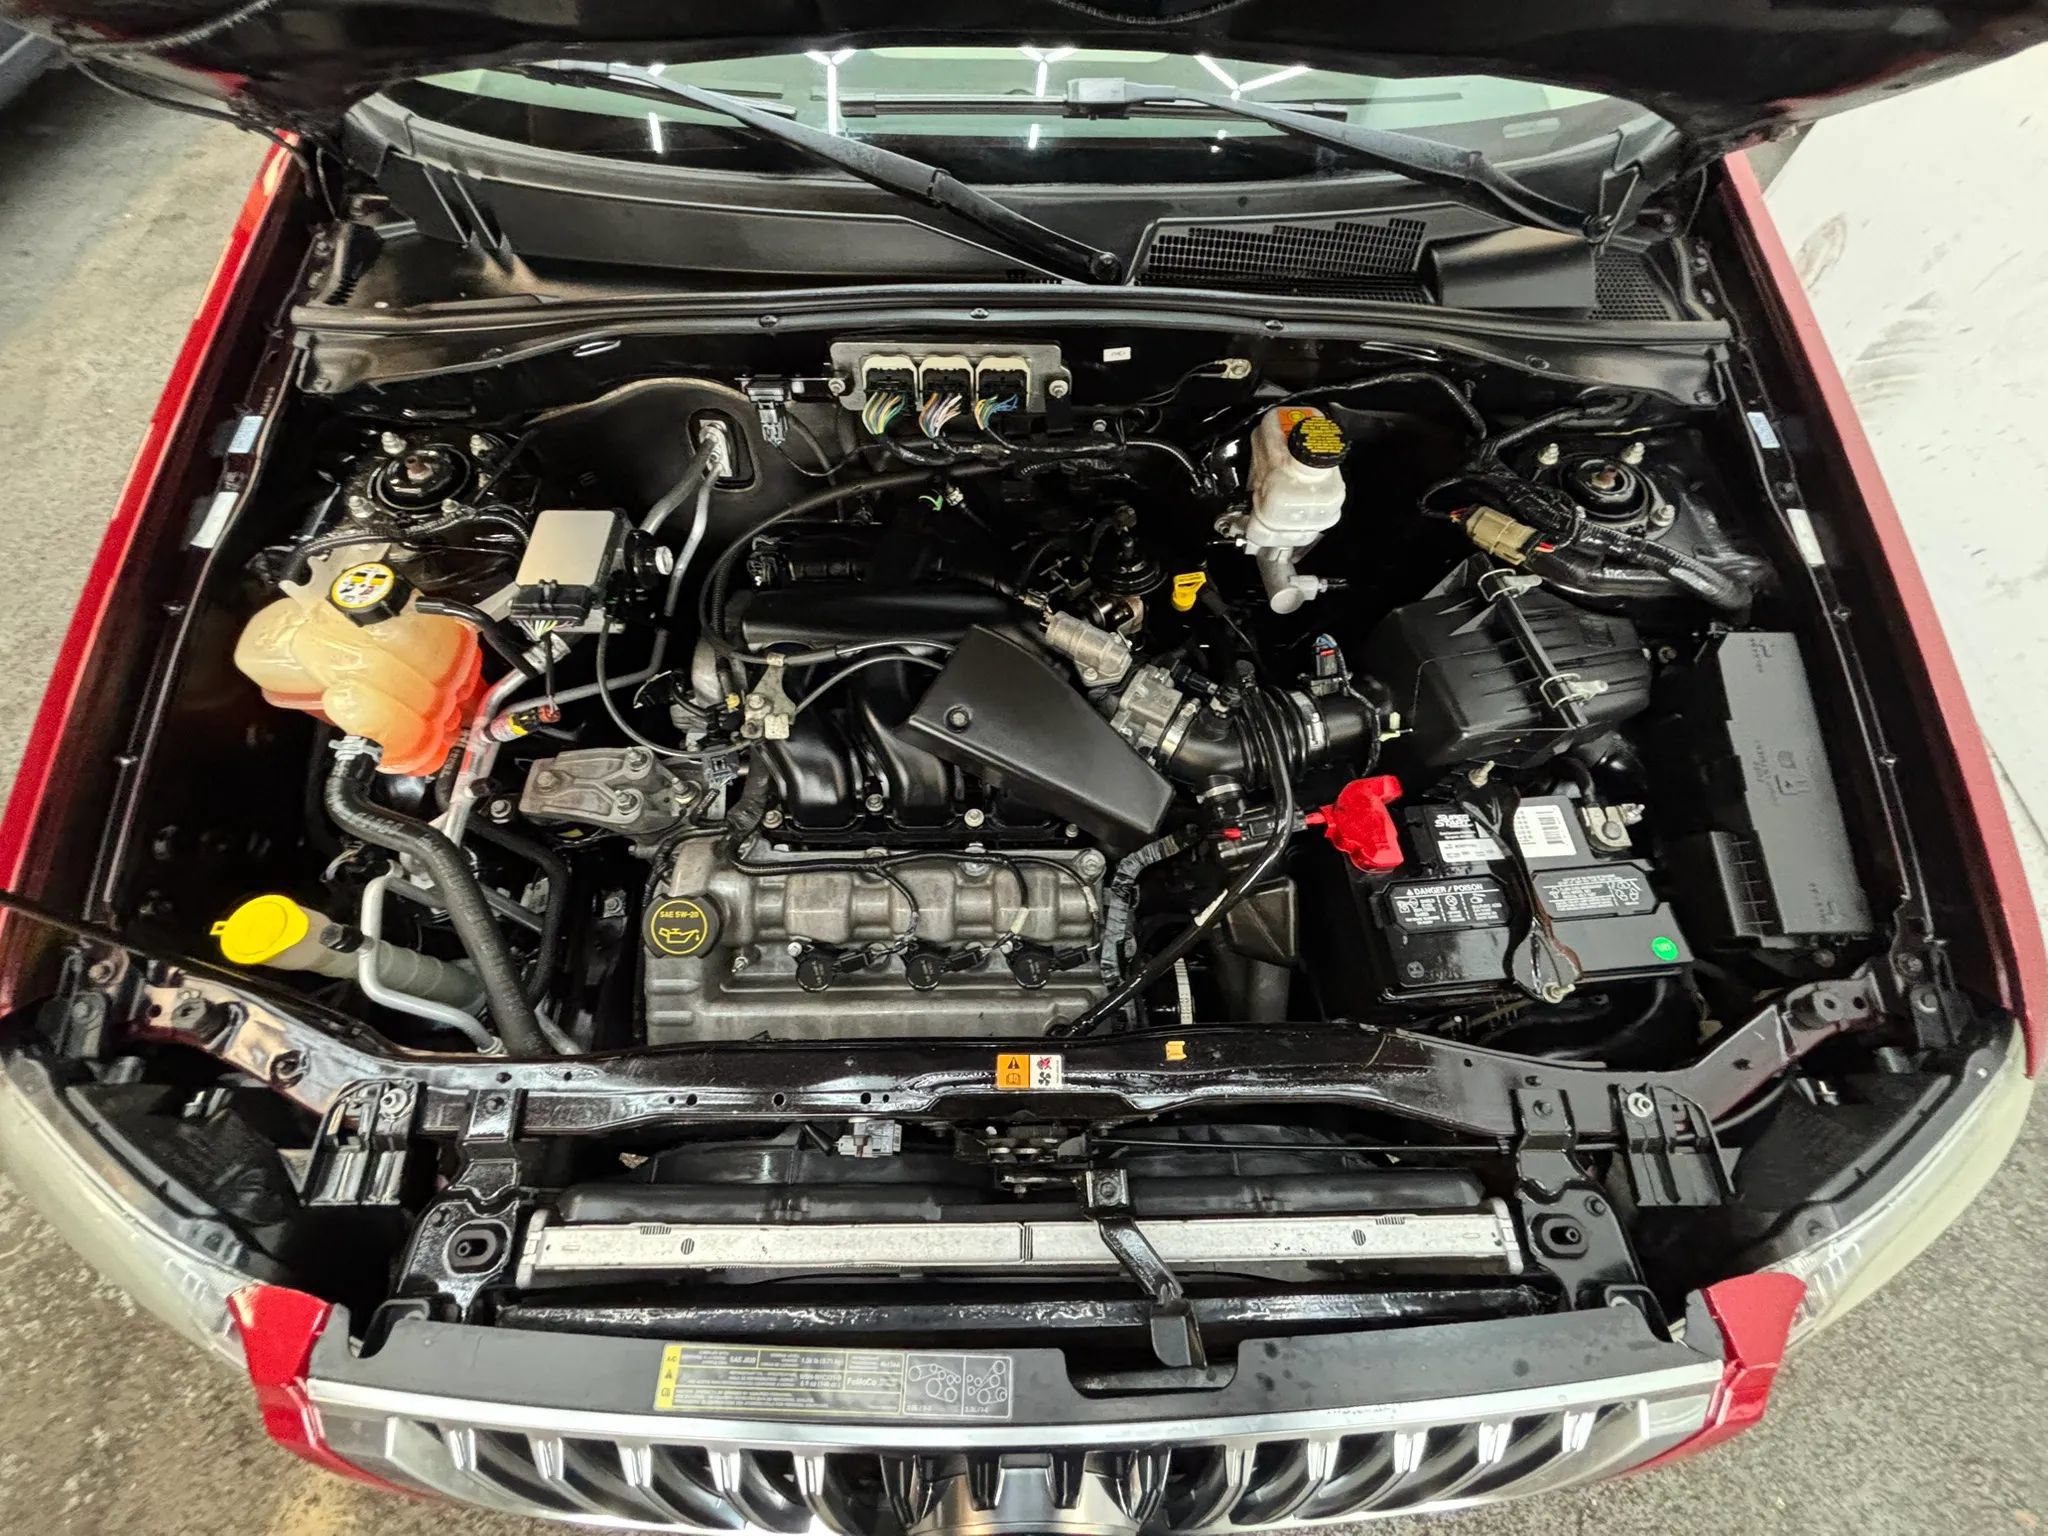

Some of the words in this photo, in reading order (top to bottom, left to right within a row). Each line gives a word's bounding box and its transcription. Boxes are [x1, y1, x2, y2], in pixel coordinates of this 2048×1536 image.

[1414, 886, 1447, 895] DANGER
[1453, 883, 1484, 892] POISON
[847, 1377, 877, 1386] FoMoCo
